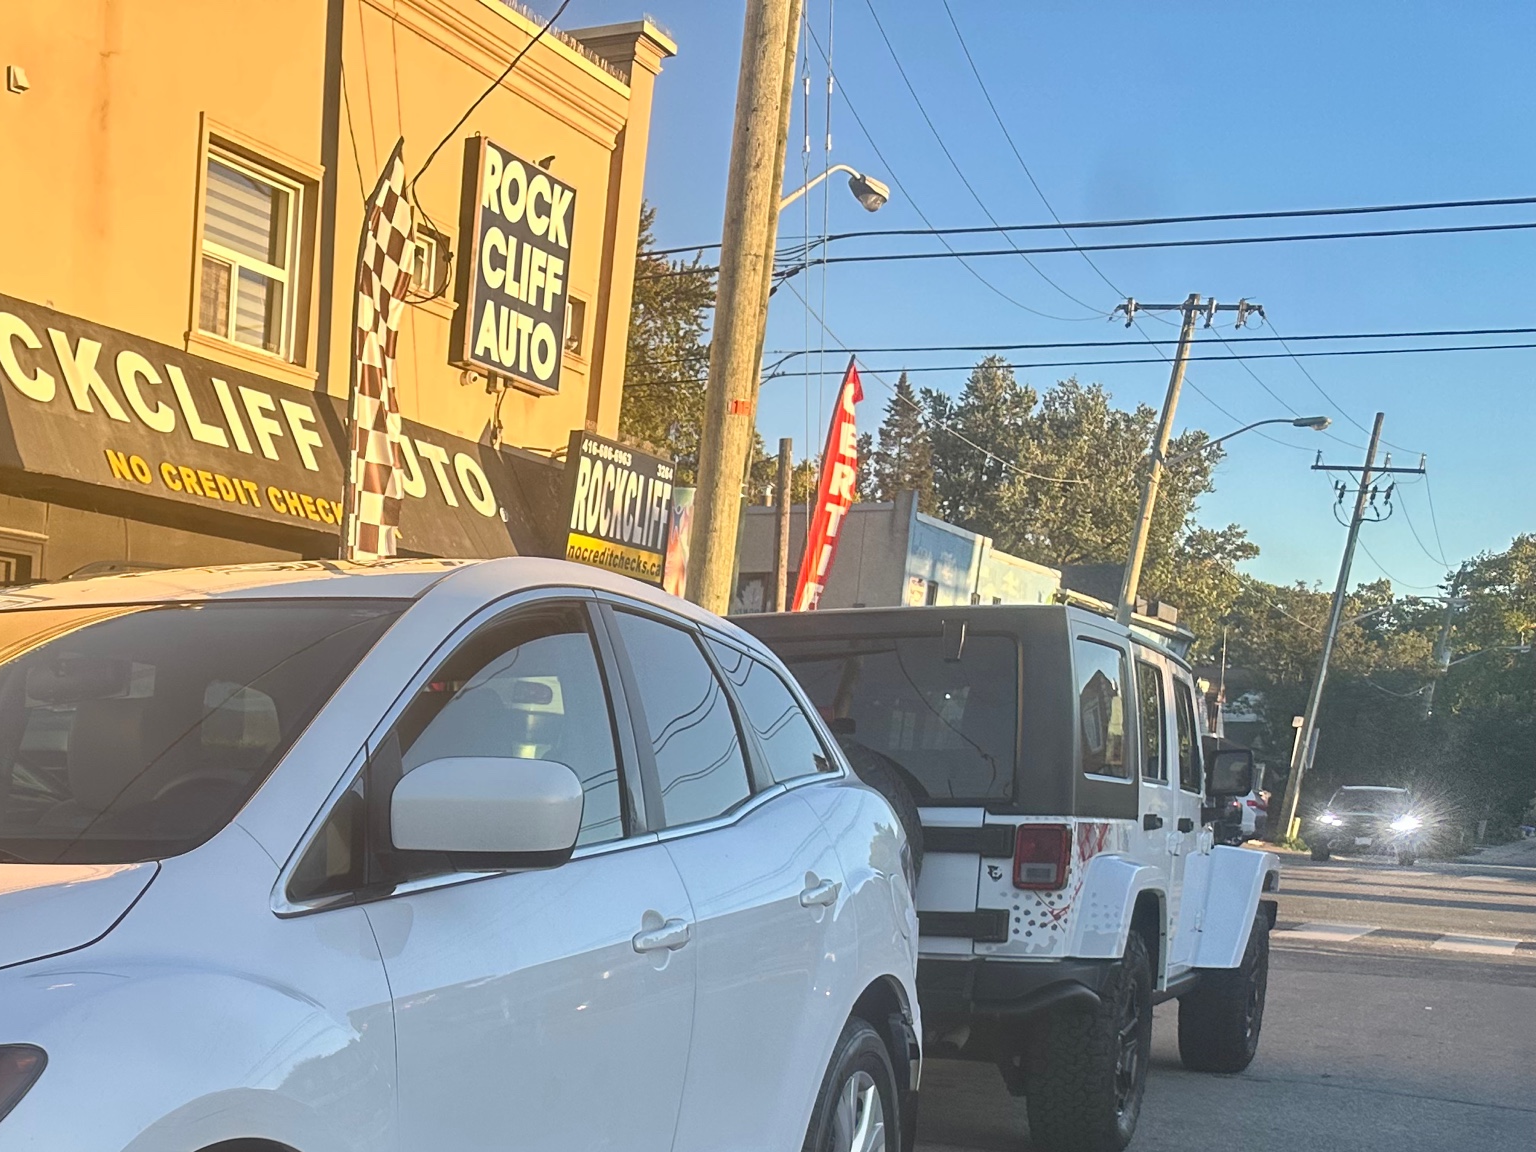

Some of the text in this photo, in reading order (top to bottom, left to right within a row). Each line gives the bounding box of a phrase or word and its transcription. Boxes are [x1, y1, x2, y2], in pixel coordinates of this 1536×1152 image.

[482, 144, 573, 249] ROCK
[482, 226, 564, 313] CLIFF
[474, 299, 557, 381] AUTO
[105, 448, 153, 485] NO
[158, 461, 263, 509] CREDIT
[570, 456, 672, 550] ROCKCLIFF
[567, 544, 661, 577] nocreditchecks.ca
